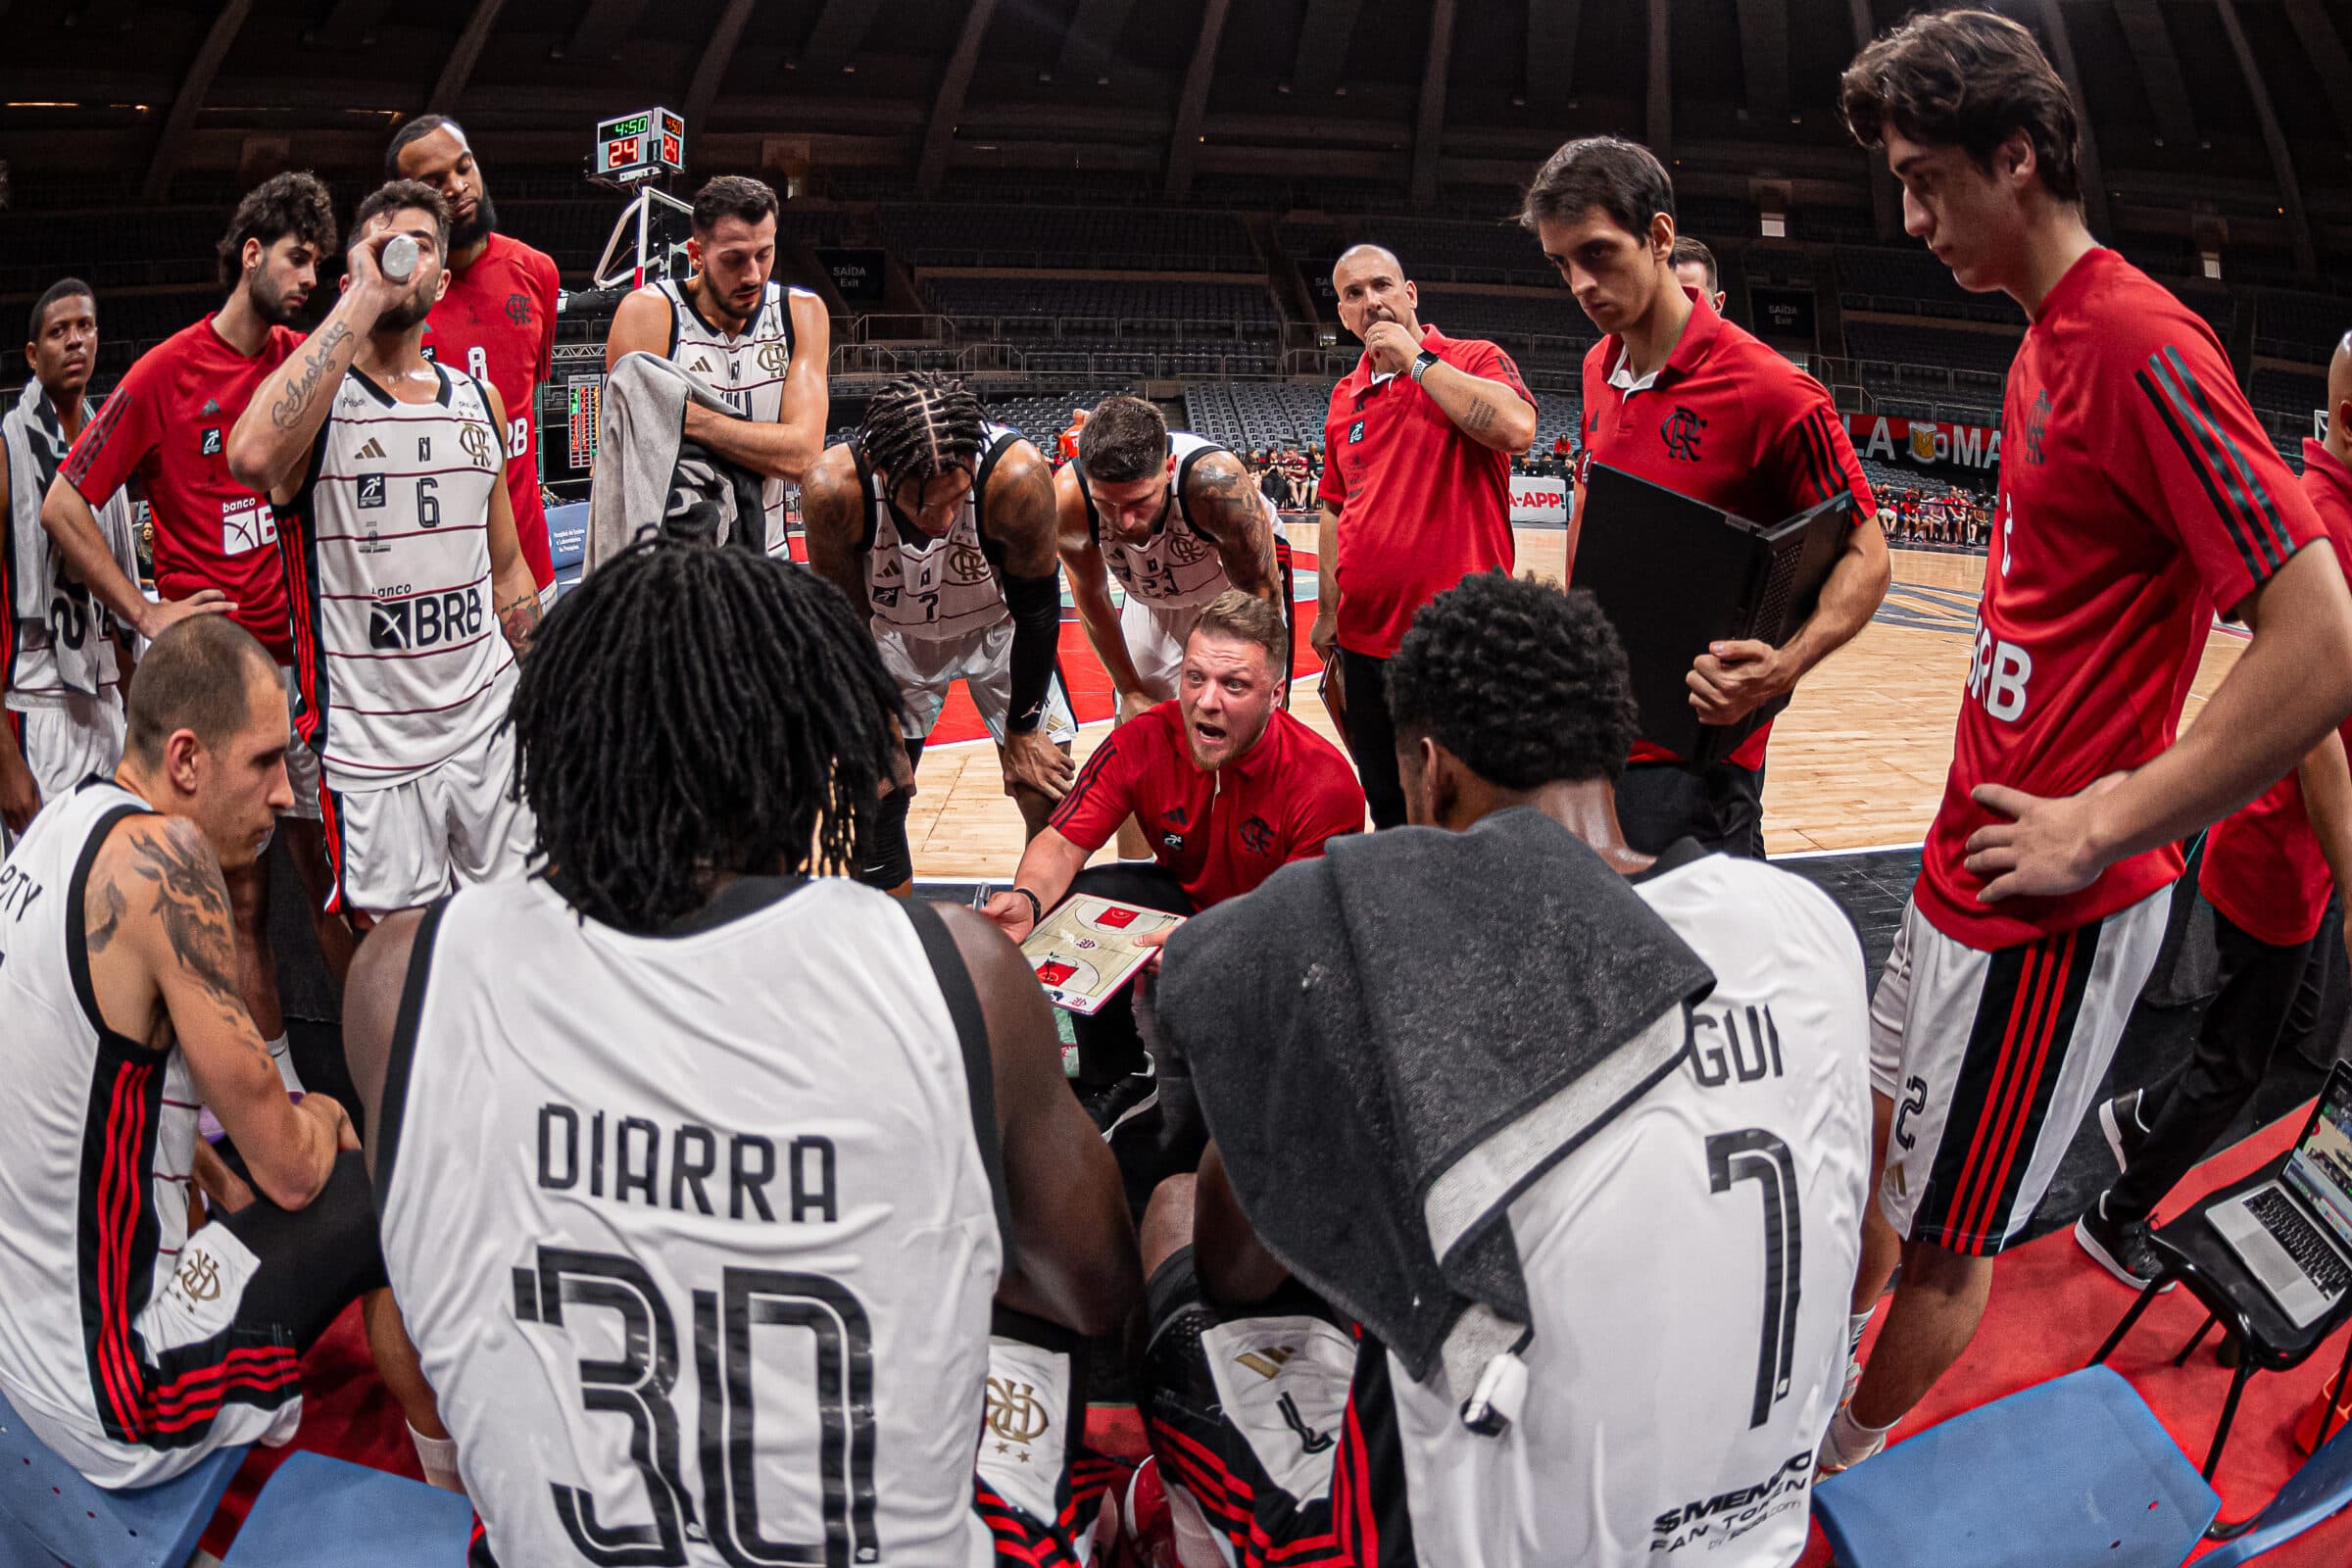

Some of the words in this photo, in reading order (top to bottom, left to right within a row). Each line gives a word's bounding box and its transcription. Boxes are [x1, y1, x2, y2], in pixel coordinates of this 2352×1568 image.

[614, 117, 648, 135] 4:50
[609, 137, 638, 168] 24
[663, 134, 678, 163] 24
[840, 277, 859, 287] Exit
[222, 497, 256, 513] banco
[416, 477, 440, 528] 6
[416, 588, 483, 647] BRB
[918, 593, 939, 621] 7
[1690, 1004, 1784, 1089] GUI
[537, 1102, 838, 1224] DIARRA
[512, 1244, 880, 1568] 30
[1648, 1524, 1709, 1553] FAN
